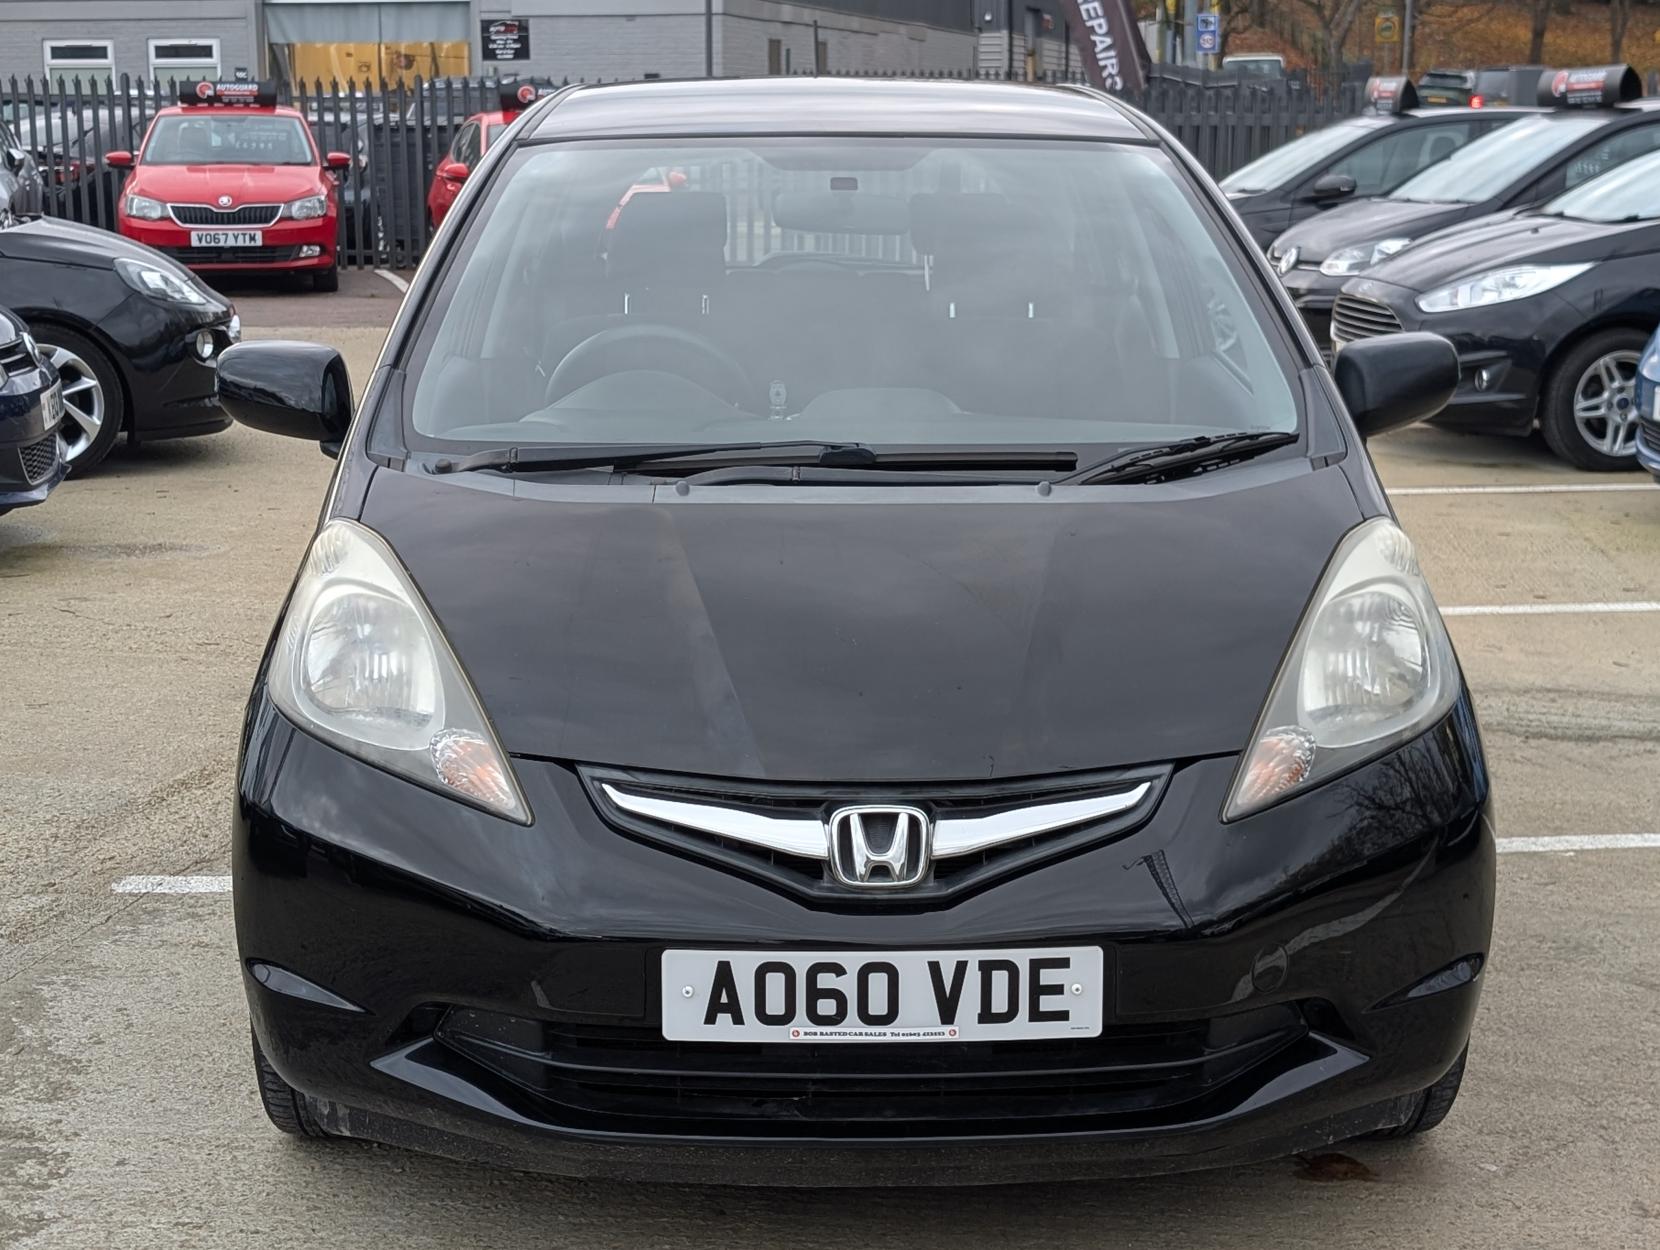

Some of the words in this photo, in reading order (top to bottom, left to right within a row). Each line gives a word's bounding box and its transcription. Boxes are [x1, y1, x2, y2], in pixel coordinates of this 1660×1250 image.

[1077, 0, 1124, 91] EPAIRS
[196, 232, 229, 245] VO67
[232, 232, 257, 245] YTM
[703, 960, 900, 1027] AO60
[927, 957, 1071, 1026] VDE
[890, 1030, 901, 1038] Tel
